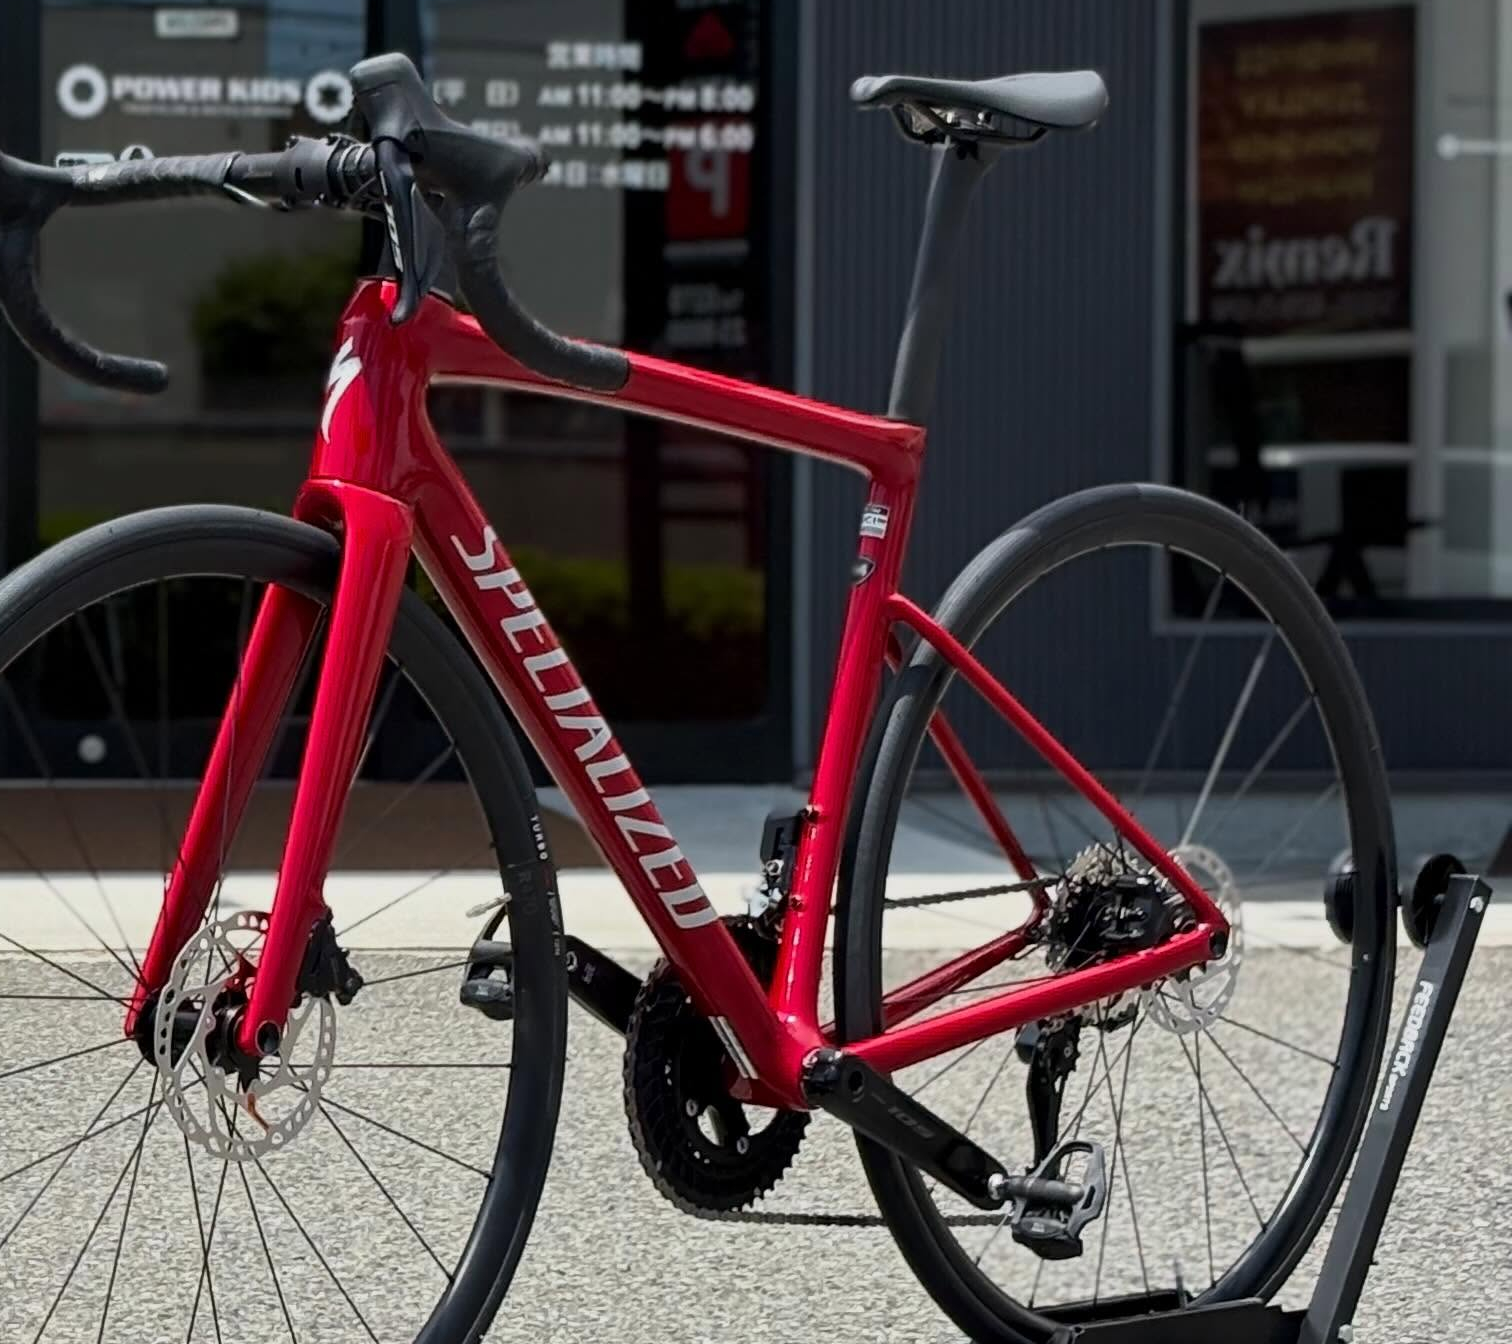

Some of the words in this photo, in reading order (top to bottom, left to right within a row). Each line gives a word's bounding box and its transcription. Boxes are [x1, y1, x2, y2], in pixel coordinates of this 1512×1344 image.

[111, 75, 222, 102] POWER
[226, 77, 303, 104] KIDS
[450, 524, 719, 929] SPECIALIZED
[529, 813, 549, 861] TURBO
[1390, 979, 1435, 1078] FEEDBACK
